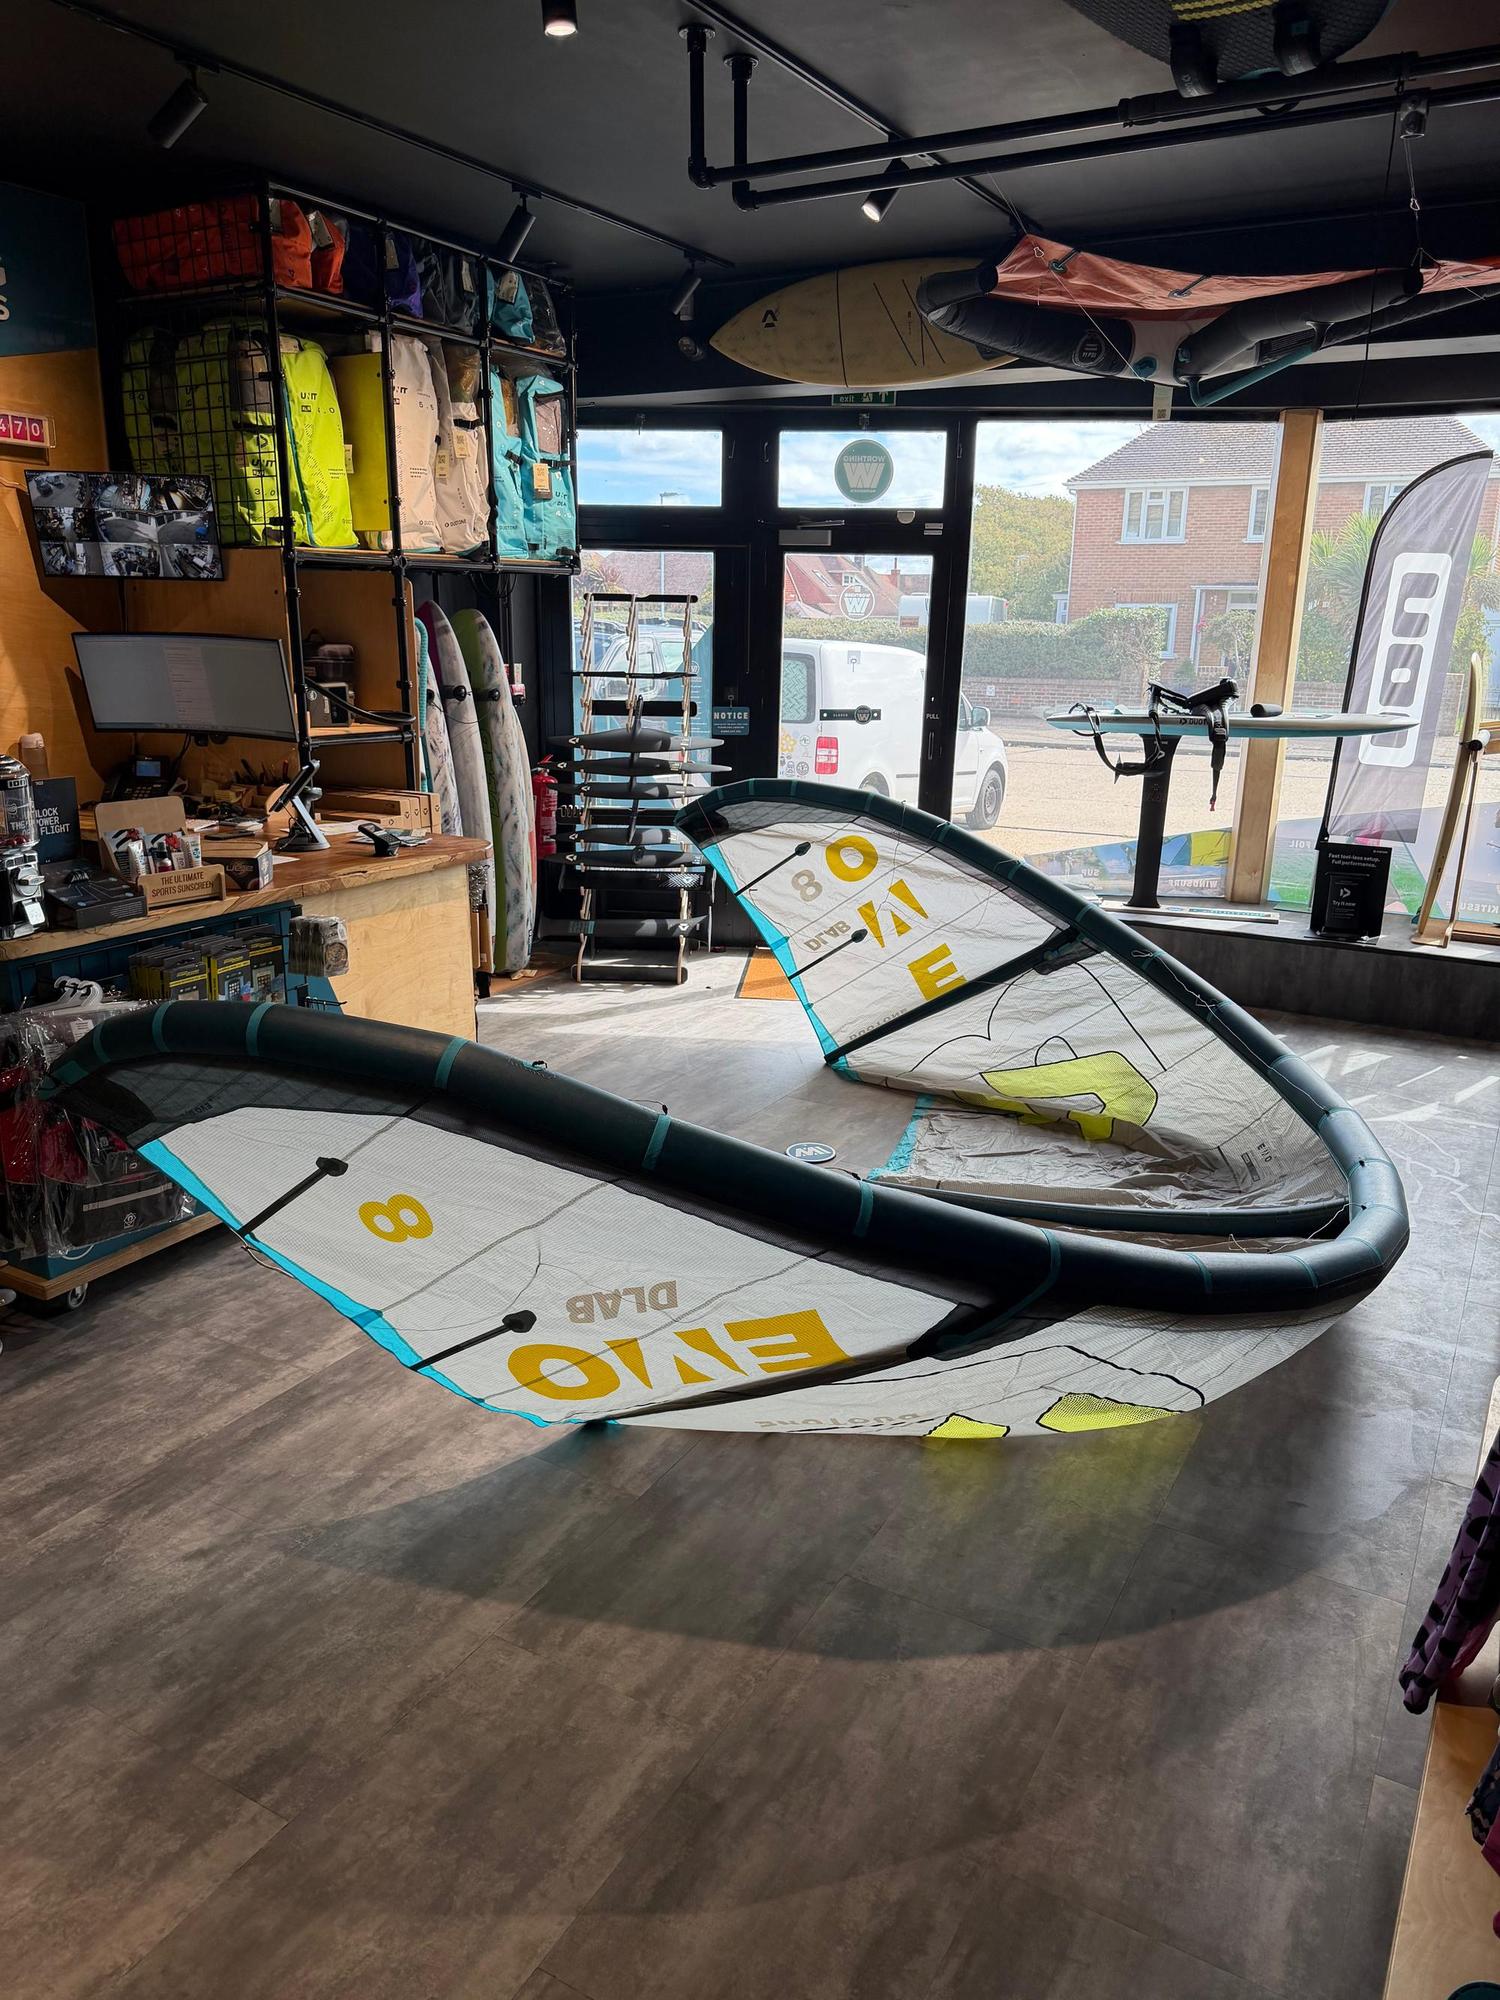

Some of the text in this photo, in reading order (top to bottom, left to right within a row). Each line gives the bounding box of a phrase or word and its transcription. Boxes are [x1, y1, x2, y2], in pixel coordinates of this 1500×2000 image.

[840, 394, 855, 403] exit
[713, 711, 749, 720] NOTICE
[40, 823, 71, 836] FLIGHT
[161, 871, 204, 887] THE ULTIMATE
[791, 869, 823, 902] 8
[151, 880, 214, 898] SPORTS SUNSCREEN
[358, 1193, 434, 1243] 8
[565, 1280, 679, 1324] DLAB
[507, 1308, 850, 1401] EVO
